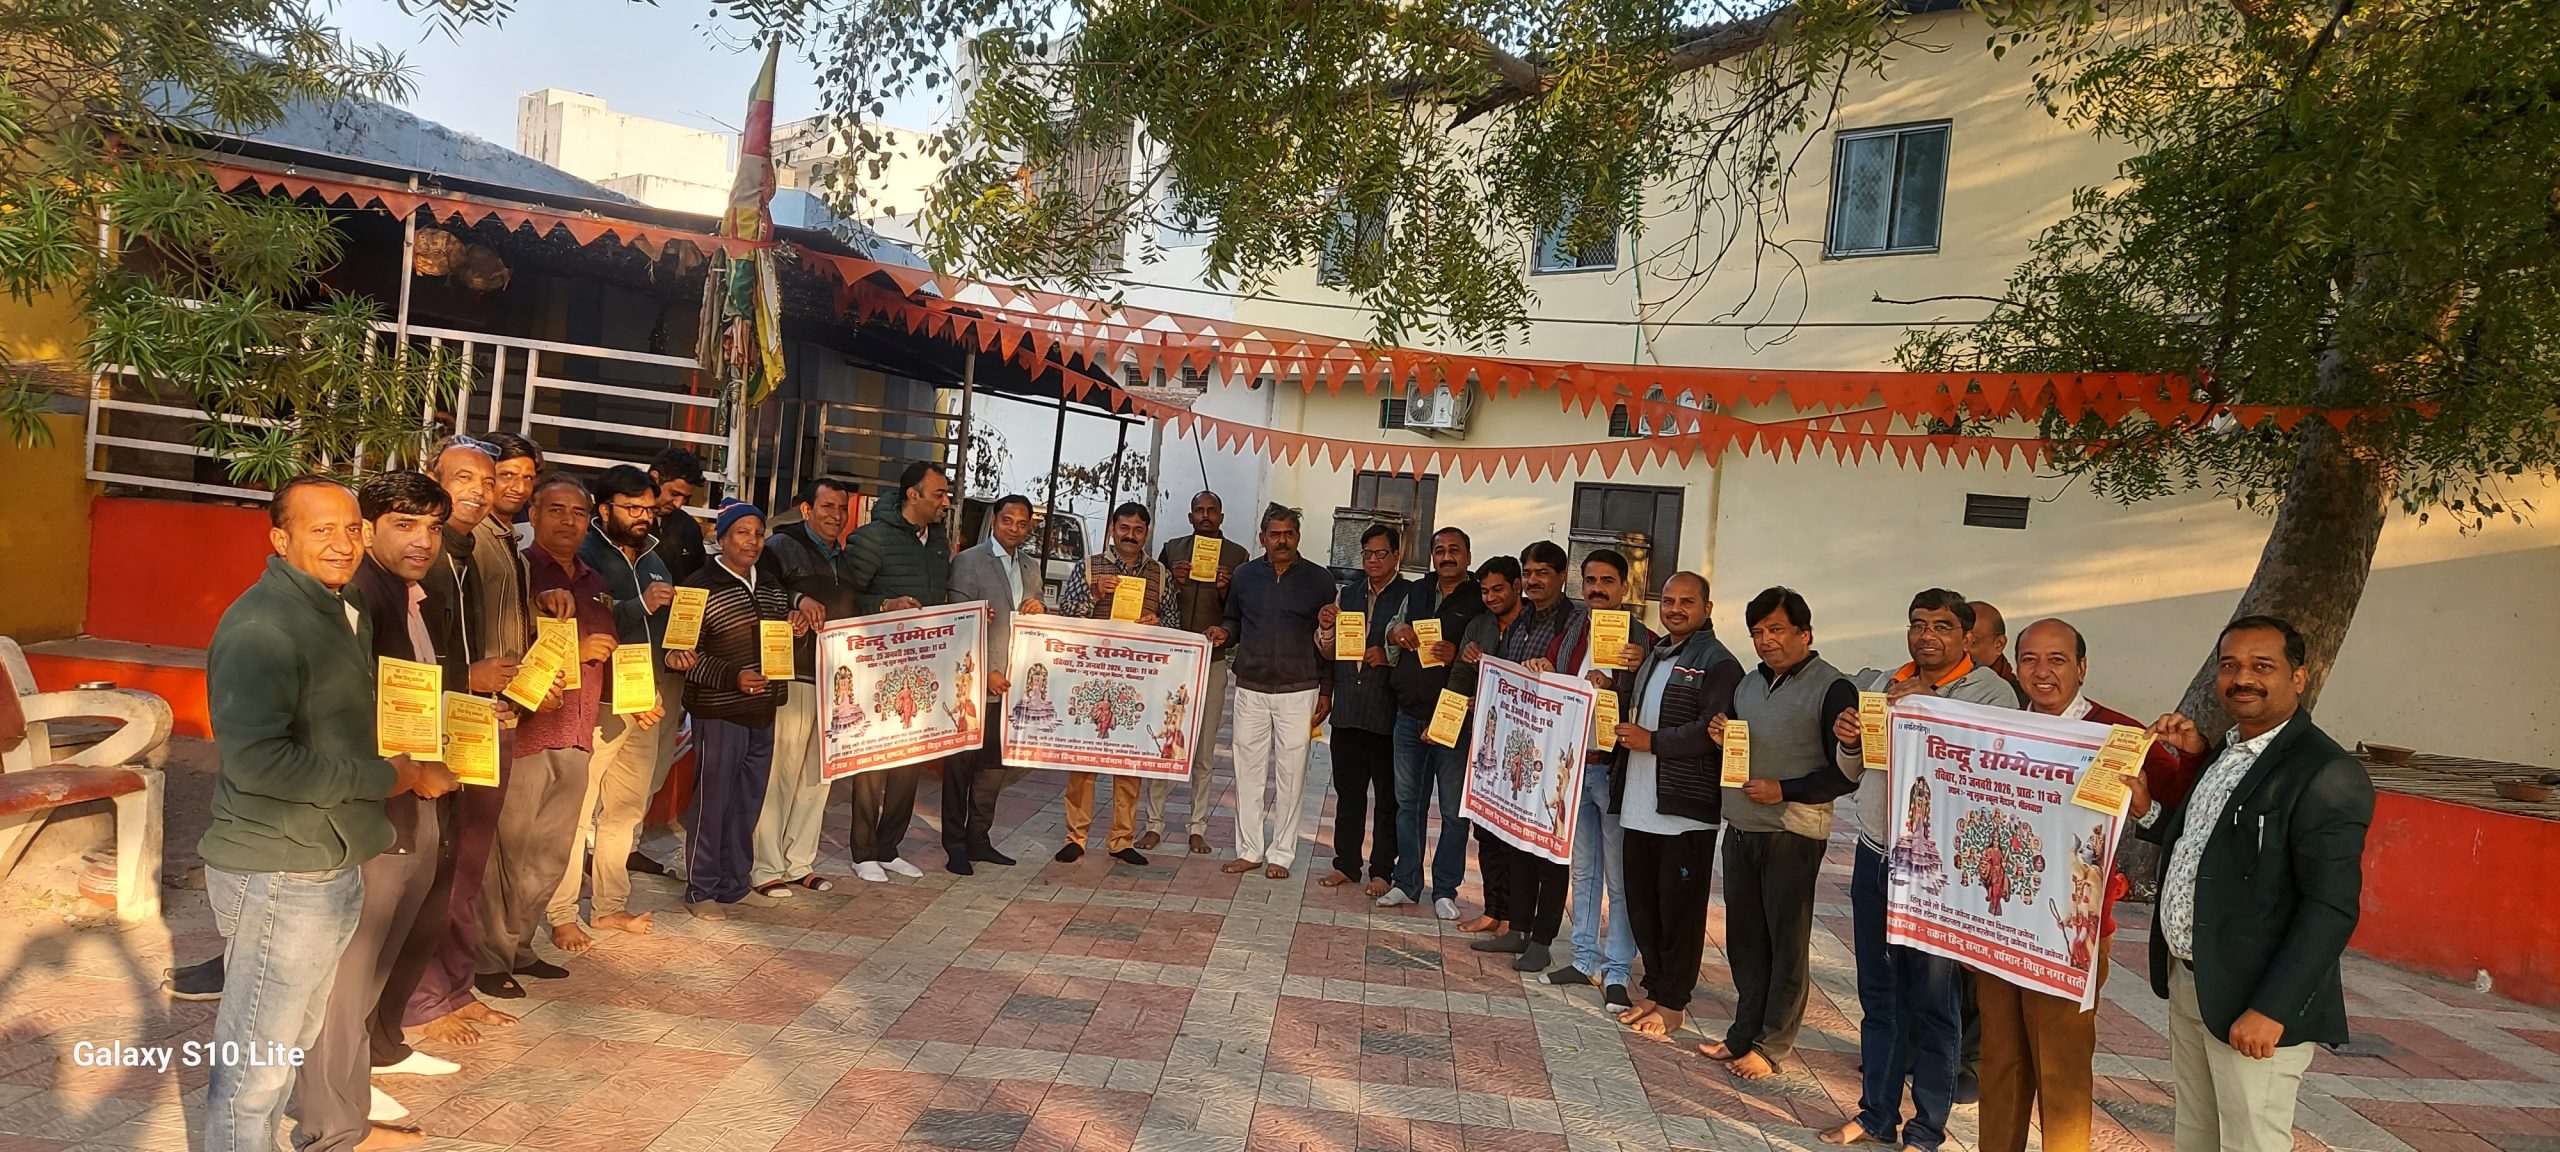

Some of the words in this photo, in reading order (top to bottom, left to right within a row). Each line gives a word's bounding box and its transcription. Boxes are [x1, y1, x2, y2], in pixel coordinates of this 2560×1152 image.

[846, 634, 888, 651] हिन्दू
[891, 624, 955, 645] सम्मेलन
[1044, 639, 1089, 660] हिन्दू
[1094, 646, 1170, 665] सम्मेलन
[1141, 666, 1147, 674] 11
[1498, 678, 1519, 705] हिन्दू
[1926, 735, 1975, 773] हिन्दू
[1980, 751, 2079, 785] सम्मेलन
[1934, 768, 1957, 785] रविवार,
[1959, 774, 1966, 785] 25
[1968, 776, 1992, 791] जनवरी
[1994, 782, 2014, 797] 2026,
[2016, 786, 2035, 799] प्रातः
[2037, 790, 2044, 802] 11
[2046, 791, 2061, 805] बजे
[1948, 932, 1966, 952] हिन्दू
